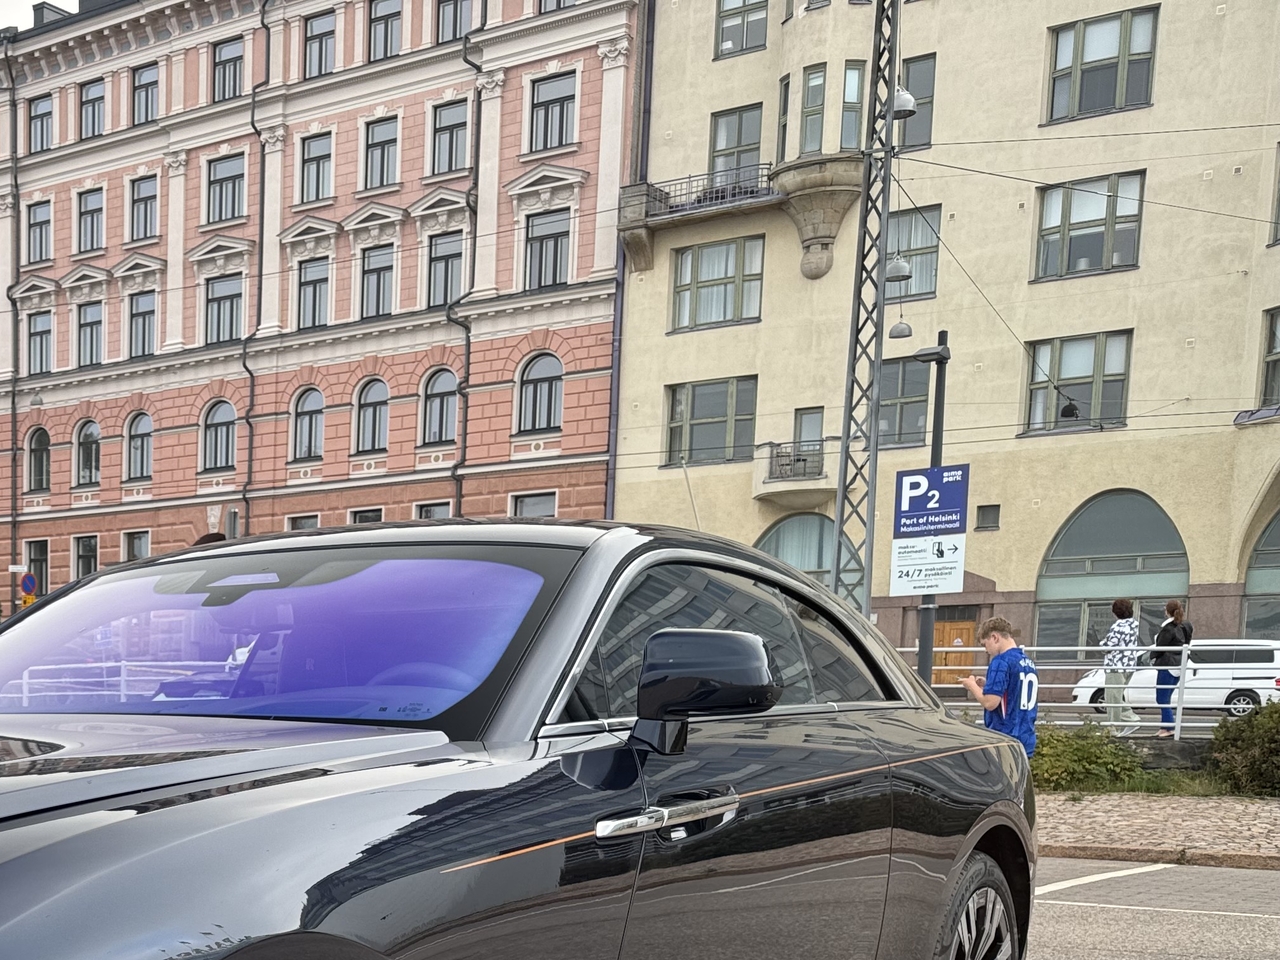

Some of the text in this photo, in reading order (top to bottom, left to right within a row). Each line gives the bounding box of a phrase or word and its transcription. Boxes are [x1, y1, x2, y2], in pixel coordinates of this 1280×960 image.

[943, 475, 962, 483] park
[901, 517, 917, 525] Port
[928, 513, 960, 522] Helsinki
[897, 568, 923, 579] 24/7
[1019, 672, 1038, 711] 10
